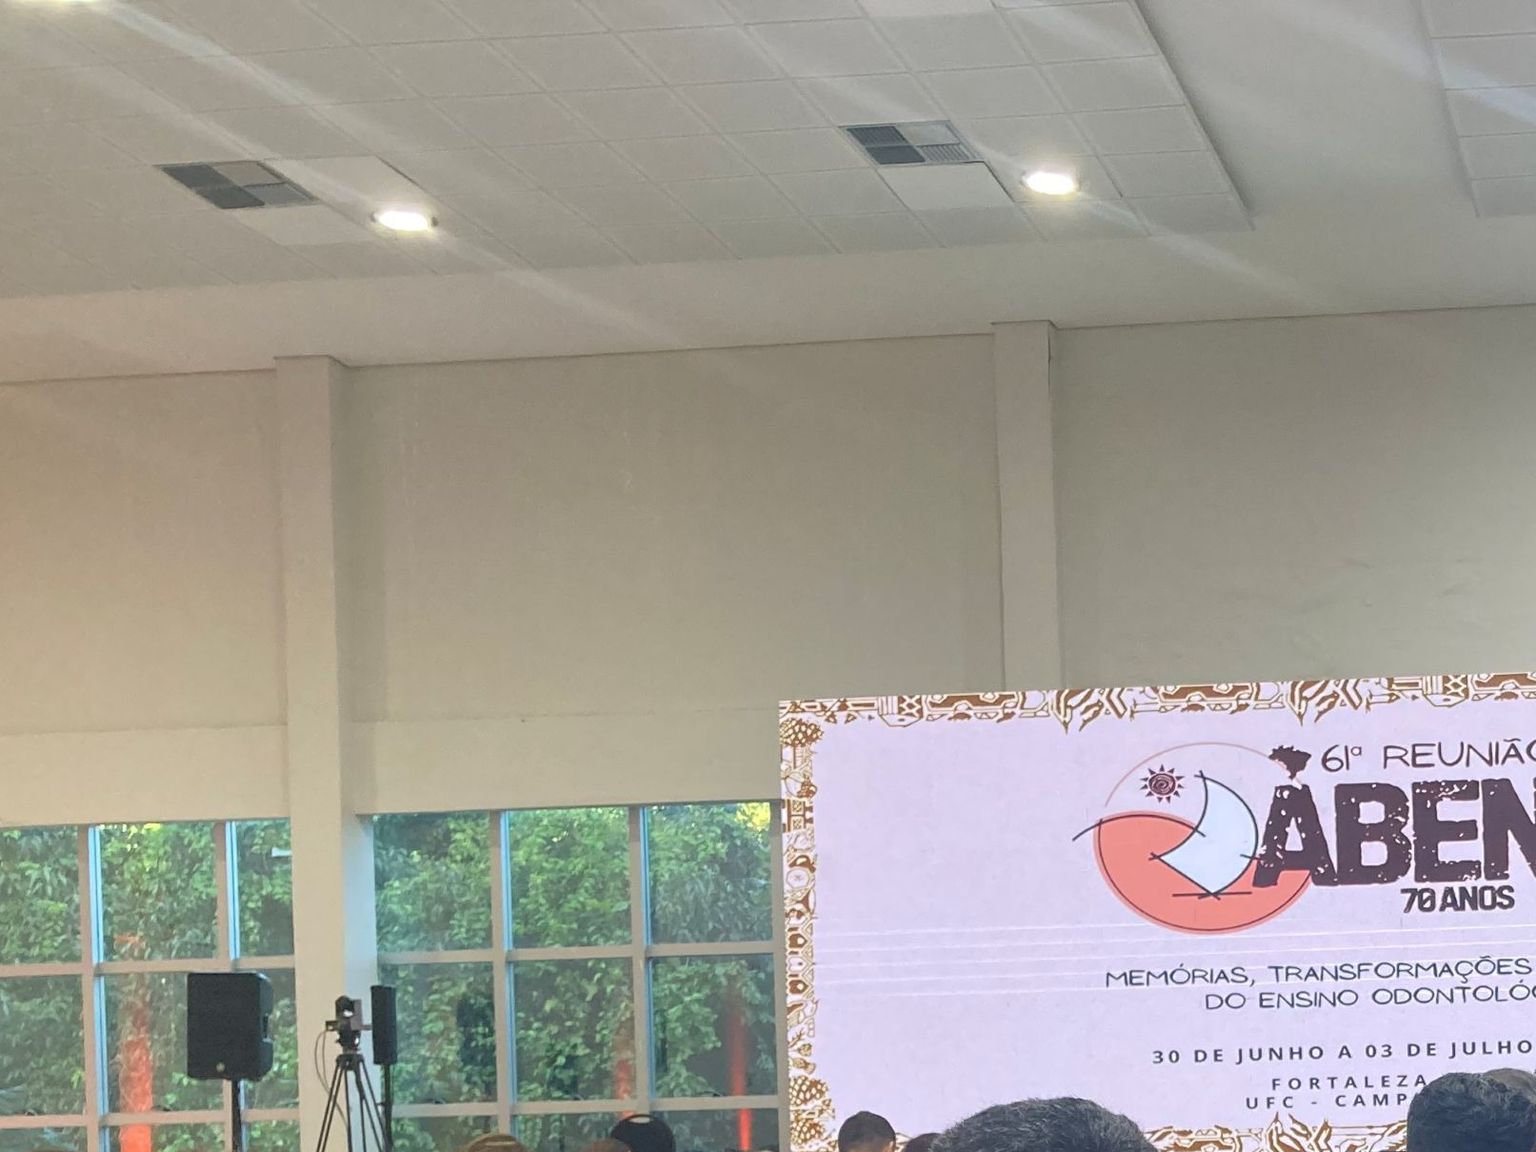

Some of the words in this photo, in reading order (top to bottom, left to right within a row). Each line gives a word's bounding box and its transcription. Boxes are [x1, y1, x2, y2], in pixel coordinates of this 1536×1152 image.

[1400, 887, 1436, 913] 70
[1438, 885, 1516, 912] ANOS
[1105, 963, 1256, 988] MEMÓRIAS,
[1267, 956, 1533, 983] TRANSFORMAÇÕES
[1205, 992, 1247, 1010] DO
[1258, 989, 1359, 1009] ENSINO
[1153, 1049, 1180, 1064] 30
[1194, 1048, 1224, 1063] DE
[1235, 1045, 1324, 1065] JUNHO
[1338, 1045, 1352, 1059] A
[1365, 1043, 1393, 1058] 03
[1407, 1042, 1437, 1057] DE
[1448, 1039, 1533, 1060] JULHO
[1271, 1074, 1427, 1091] FORTALEZA
[1245, 1096, 1294, 1110] UFC
[1335, 1093, 1408, 1108] CAMP
